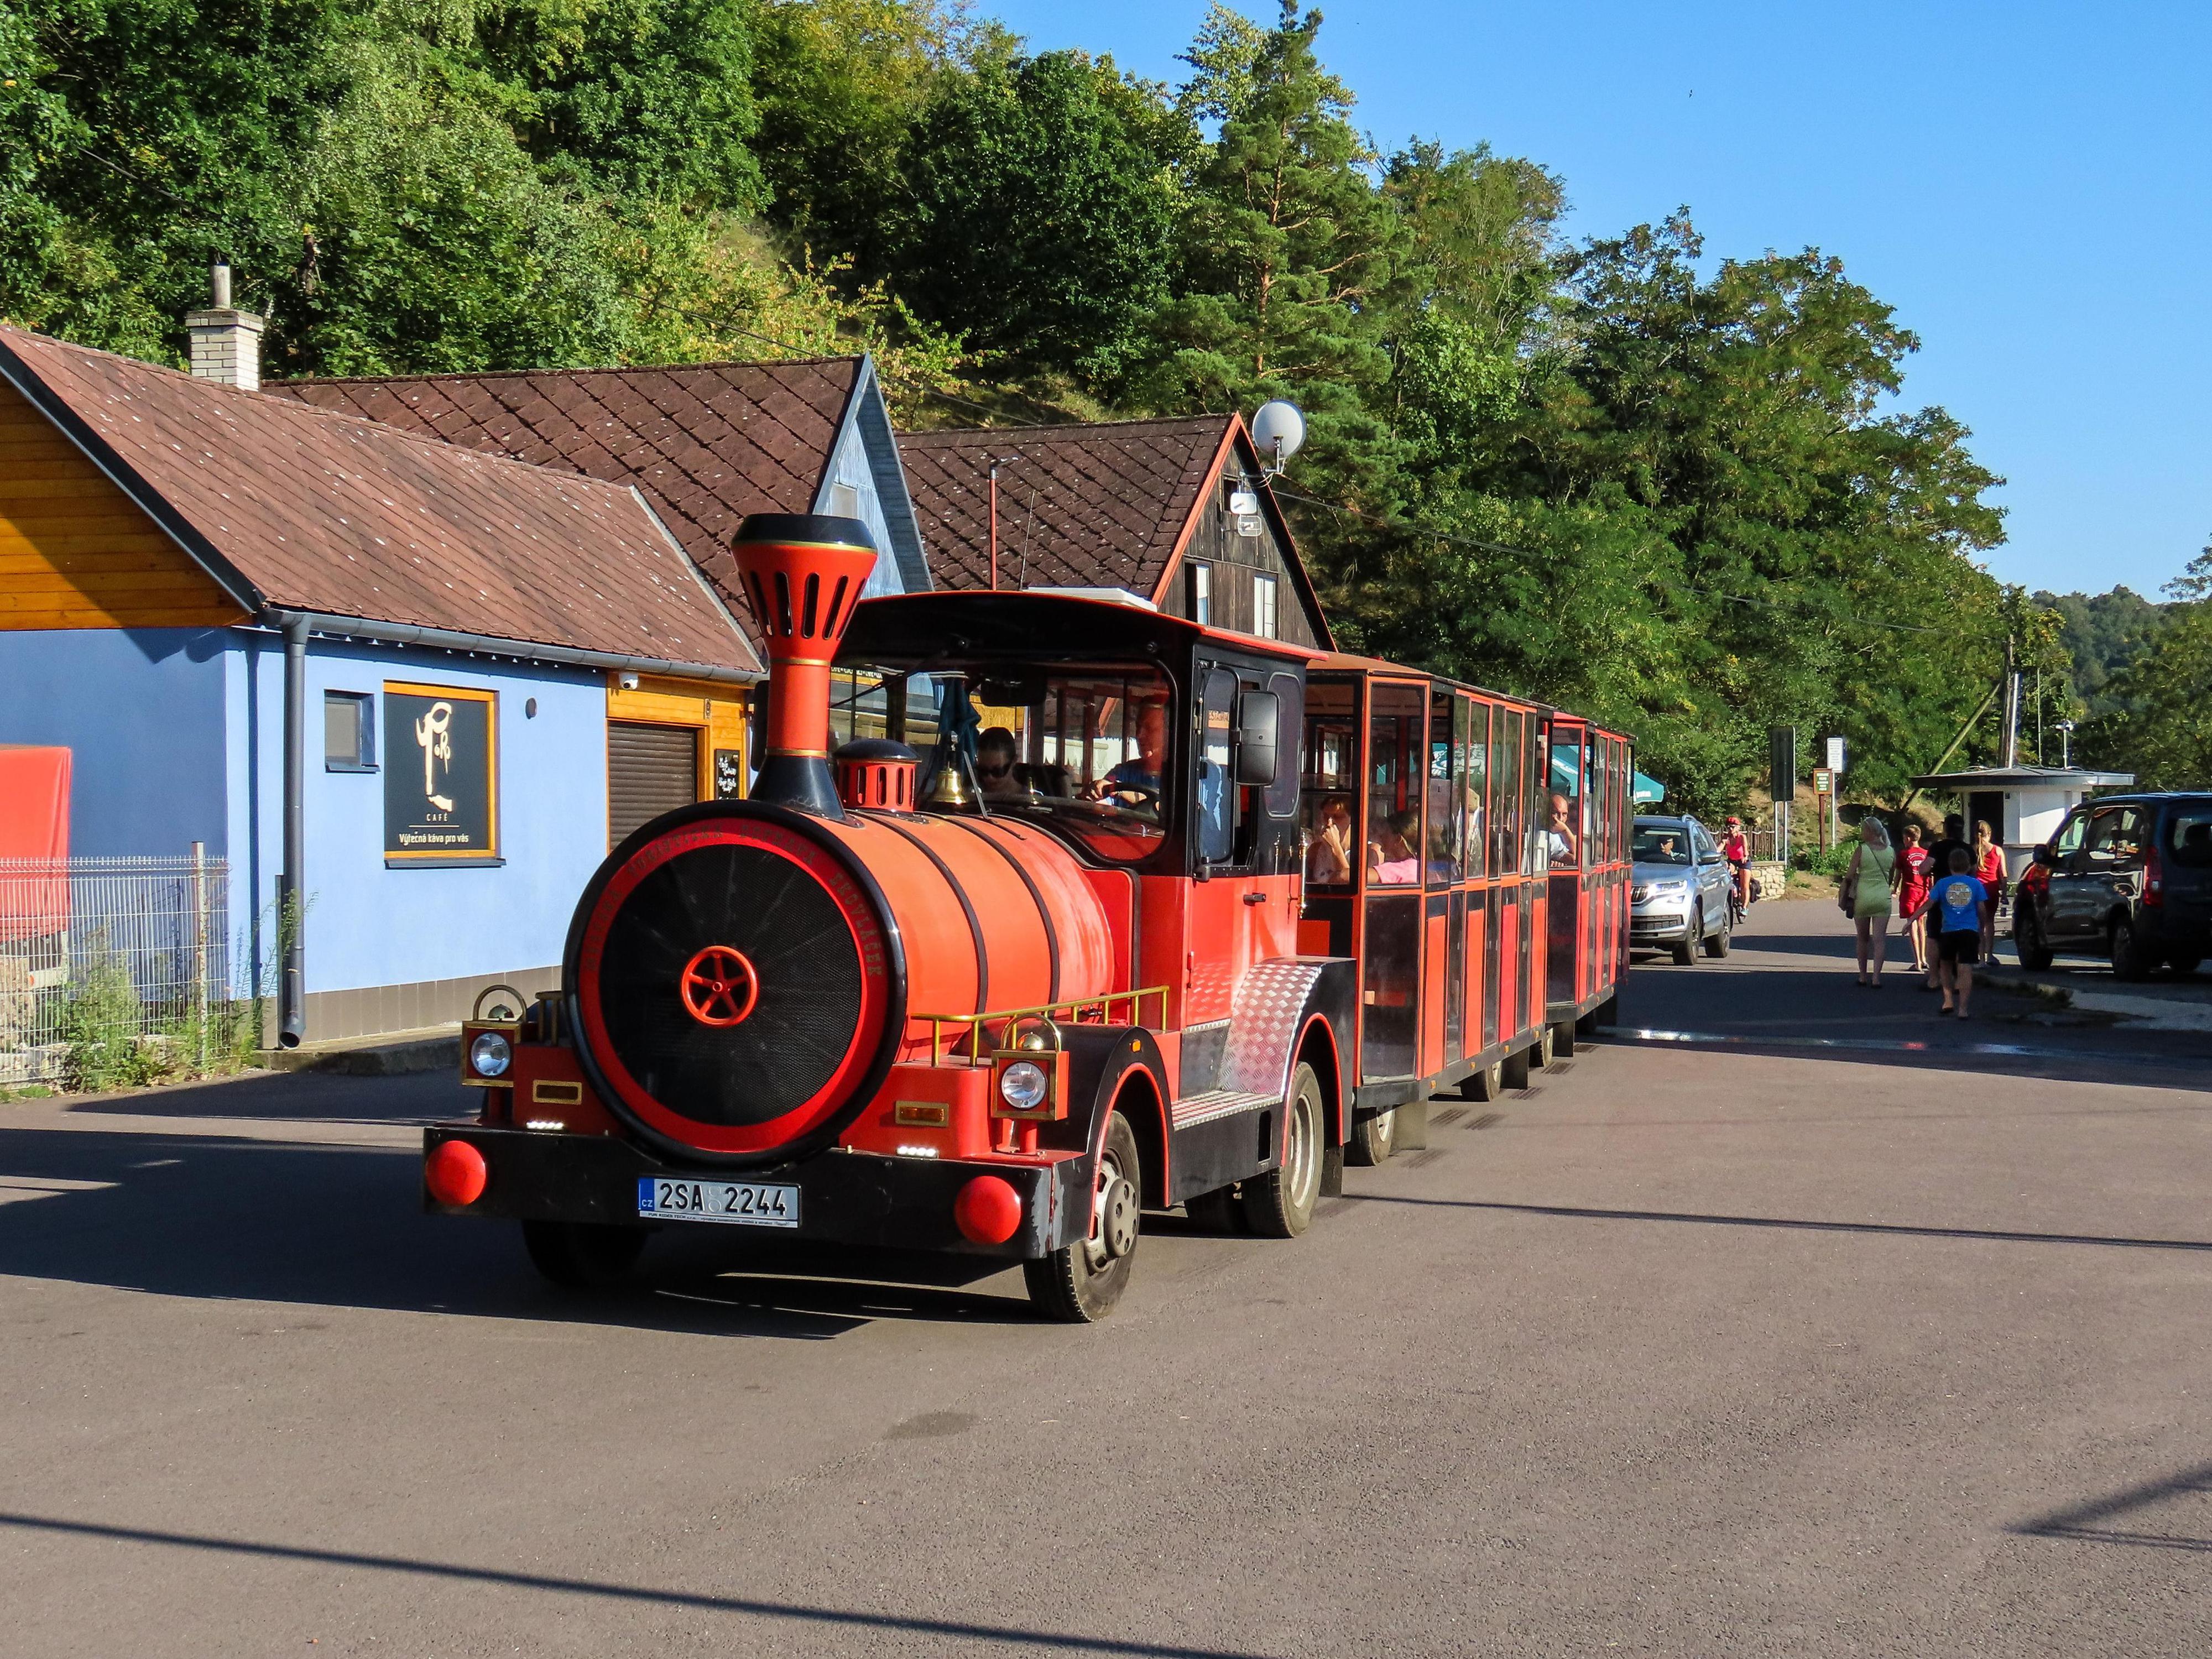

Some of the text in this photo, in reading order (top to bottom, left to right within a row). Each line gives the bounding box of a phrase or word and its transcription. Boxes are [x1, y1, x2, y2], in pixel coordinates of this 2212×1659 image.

[426, 812, 448, 822] CAFÉ
[399, 831, 469, 846] Výtečná káva pro vás
[641, 1199, 653, 1208] CZ
[659, 1182, 787, 1216] 2SA 2244
